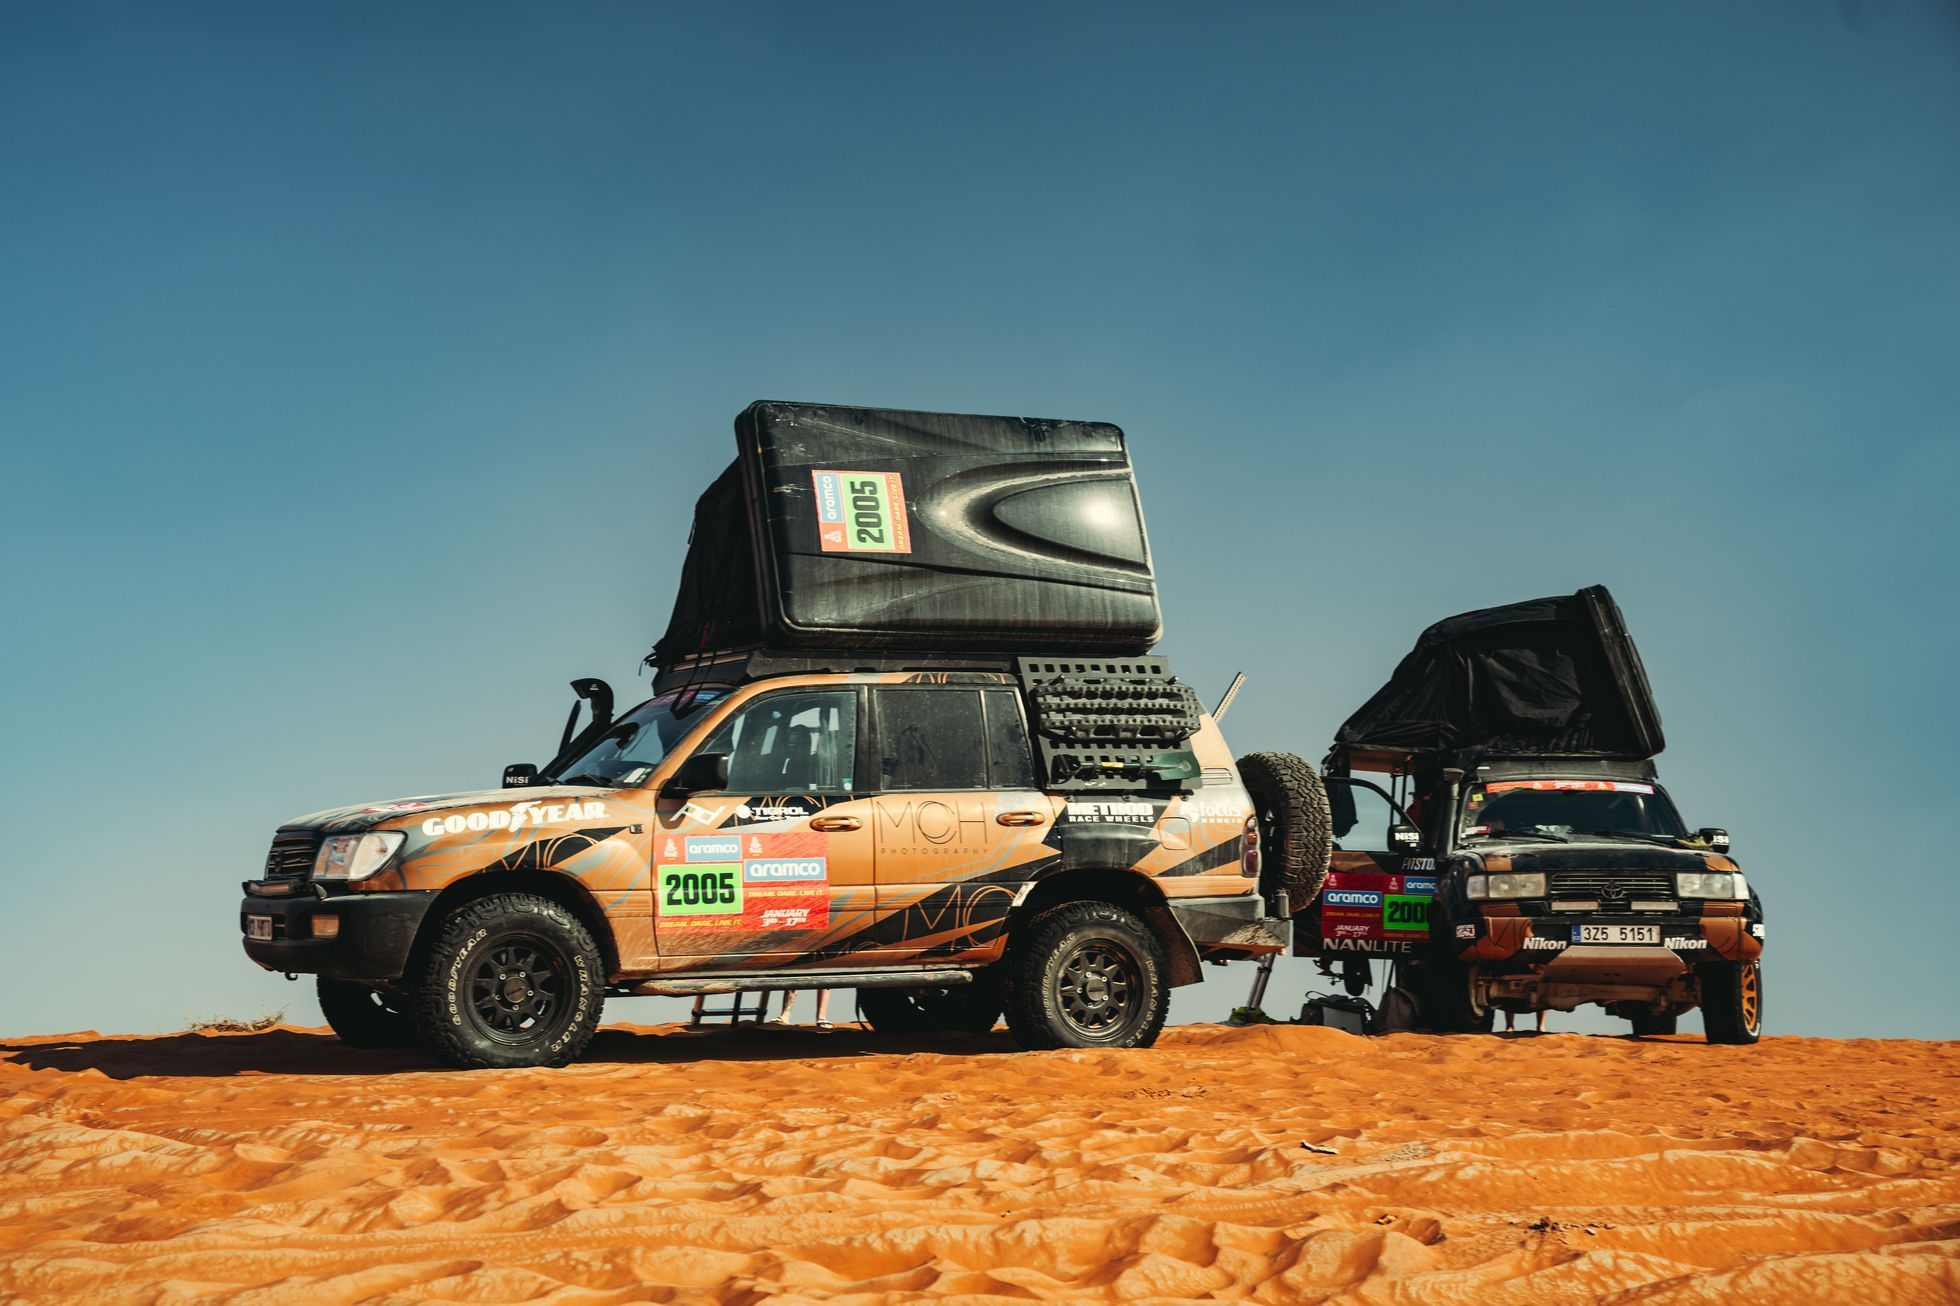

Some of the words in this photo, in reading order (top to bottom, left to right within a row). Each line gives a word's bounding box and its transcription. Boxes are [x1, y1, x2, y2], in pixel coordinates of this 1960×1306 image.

[822, 475, 838, 520] aramco
[849, 480, 884, 544] 2005
[505, 776, 529, 784] NiSi
[752, 806, 809, 816] TIGROL
[1067, 802, 1154, 816] METHOD
[422, 801, 609, 836] GOODYEAR
[876, 801, 988, 845] MCH
[1068, 815, 1100, 823] RACE
[1105, 815, 1155, 823] WHEELS
[689, 843, 739, 855] aramco
[750, 862, 821, 878] aramco
[1402, 857, 1436, 871] PITSTO
[665, 872, 736, 906] 2005
[1406, 881, 1437, 890] aramc
[1327, 892, 1379, 905] aramco
[760, 908, 812, 919] JANUARY
[1388, 901, 1431, 925] 200
[1333, 924, 1370, 932] JANUARY
[1583, 926, 1609, 942] 3Z5
[1619, 927, 1653, 942] 5151
[1322, 938, 1413, 953] NANLITE
[1522, 937, 1568, 950] Nikon
[1663, 936, 1708, 950] Nikon
